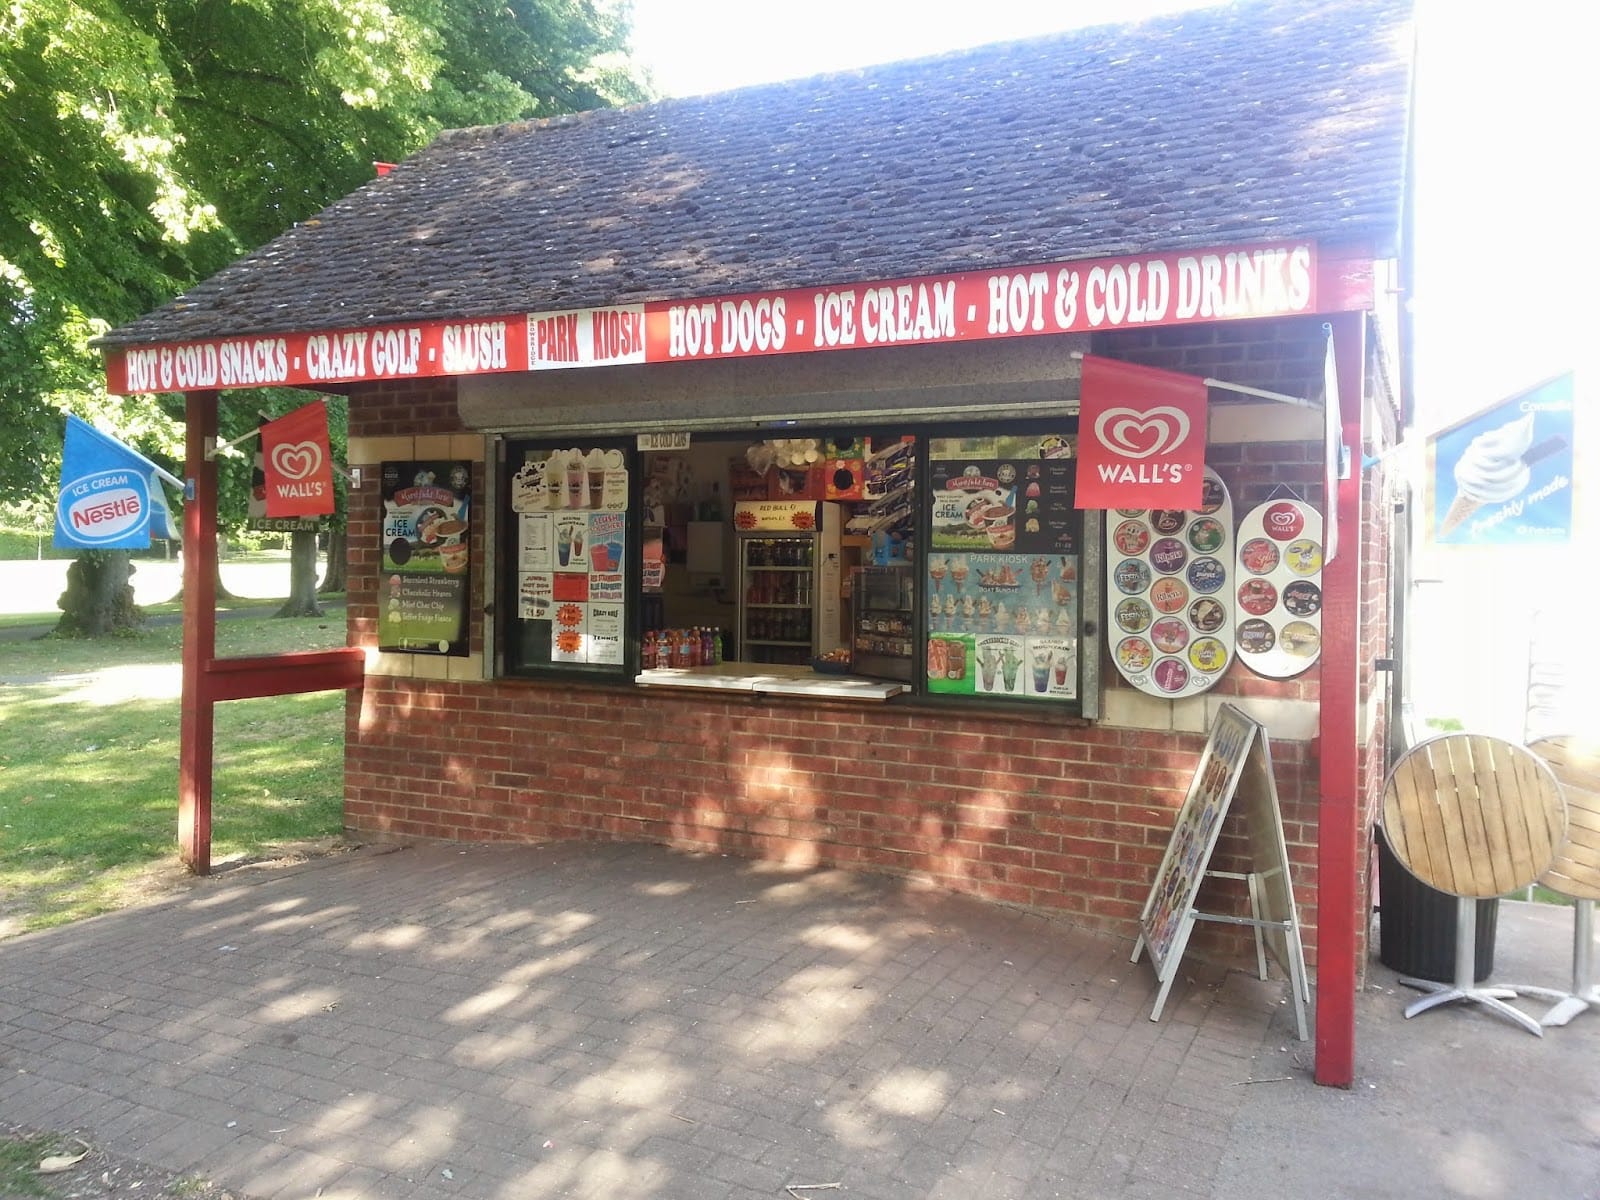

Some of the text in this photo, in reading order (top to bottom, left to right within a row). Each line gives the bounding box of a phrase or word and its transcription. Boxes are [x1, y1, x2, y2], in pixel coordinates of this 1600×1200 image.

[987, 245, 1311, 334] HOT & COLD DRINKS
[814, 280, 956, 347] ICE CREAM
[537, 310, 643, 362] PARK KIOSK
[668, 297, 786, 357] HOT DOGS
[306, 328, 422, 379] CRAZY GOLF
[443, 321, 507, 373] SLUSH
[126, 338, 288, 391] HOT & COLD SNACKS
[1097, 463, 1183, 484] WALL'S
[72, 475, 128, 497] ICE CREAM
[276, 481, 323, 498] WALL'S
[252, 520, 314, 531] ICE CREAM
[393, 520, 408, 528] ICE
[935, 511, 963, 519] CREAM
[386, 528, 416, 537] CREAM
[970, 554, 1029, 564] PARK KIOSK
